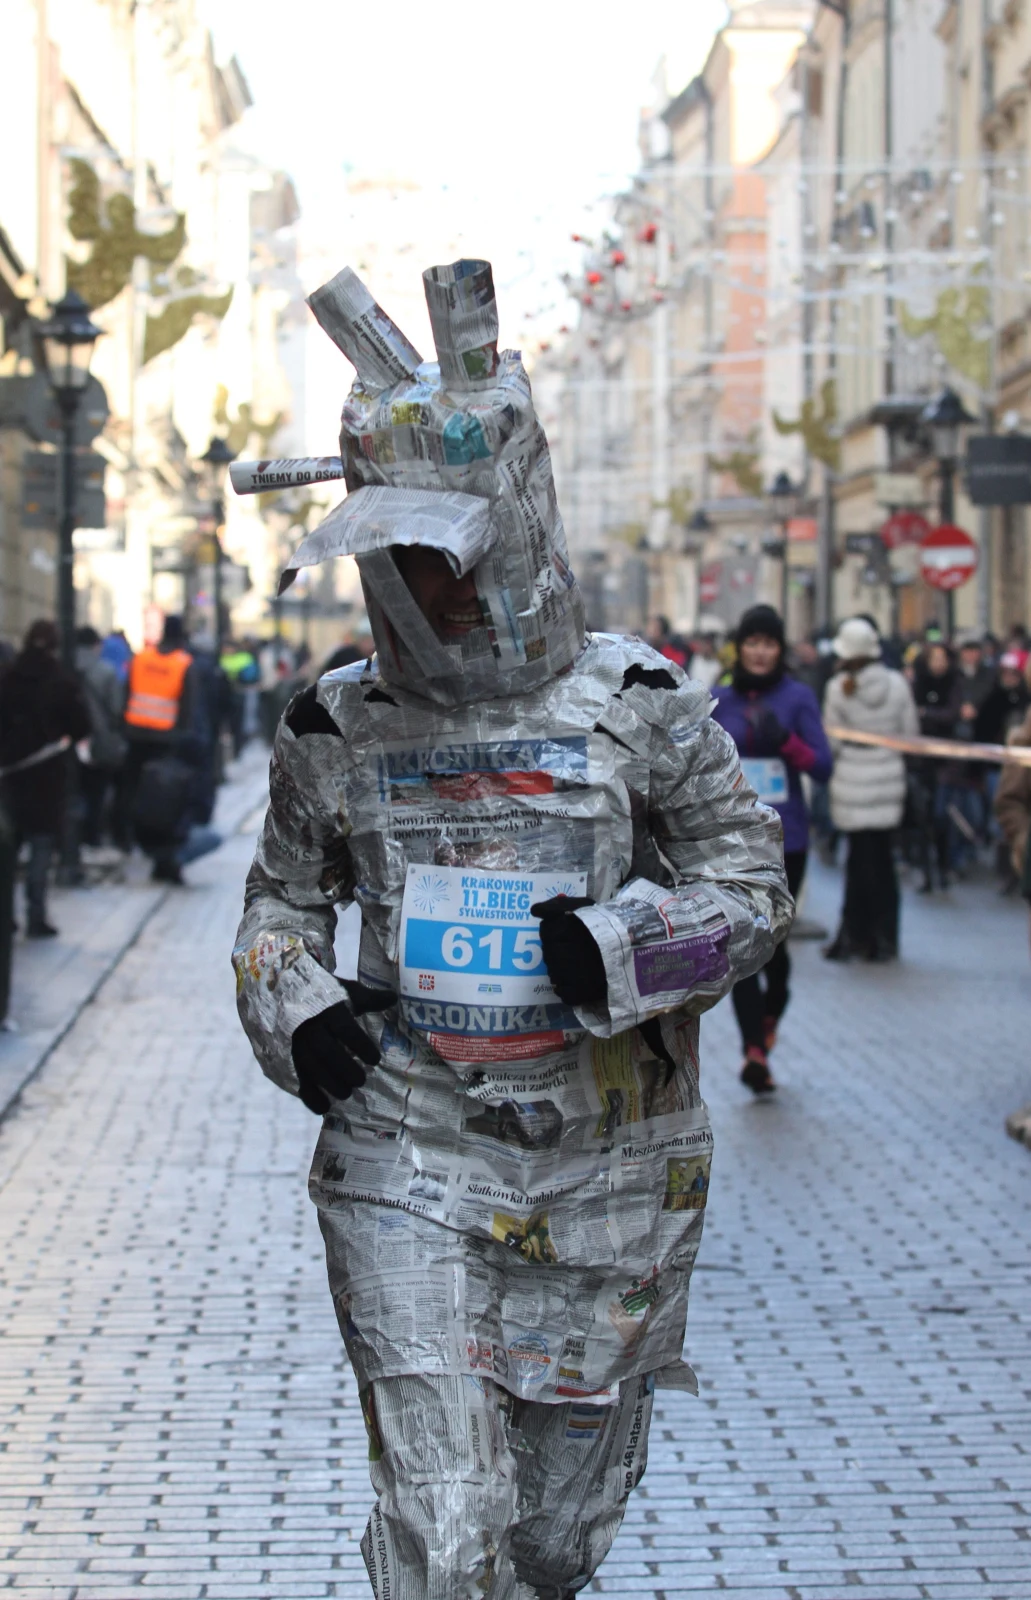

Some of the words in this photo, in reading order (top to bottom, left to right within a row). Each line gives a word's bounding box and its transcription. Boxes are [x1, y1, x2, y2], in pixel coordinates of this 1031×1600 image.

[360, 313, 394, 358] Rekordowa
[250, 471, 293, 485] TNIEMY
[296, 470, 311, 482] DO
[535, 582, 551, 624] złoych
[390, 743, 540, 776] KRONIKA
[393, 813, 424, 828] Nowi
[393, 826, 452, 842] podwyżk
[456, 826, 470, 837] na
[523, 817, 544, 831] rok
[460, 875, 534, 892] KRAKOWSKI
[462, 889, 531, 911] 11.BIEG
[458, 907, 532, 922] SYLWESTROWY
[440, 925, 545, 972] 615
[400, 1002, 552, 1032] KRONIKA
[487, 1070, 526, 1083] walczą
[528, 1072, 538, 1081] o
[511, 1083, 528, 1093] na
[528, 1073, 569, 1094] zabytki
[378, 1194, 411, 1211] nadal
[411, 1203, 434, 1216] nic
[465, 1182, 524, 1205] Siatkówka
[525, 1190, 554, 1206] nadal
[626, 1404, 643, 1450] latach
[471, 1413, 486, 1473] STATOLOGIA
[624, 1471, 633, 1490] po
[378, 1540, 390, 1576] reszta
